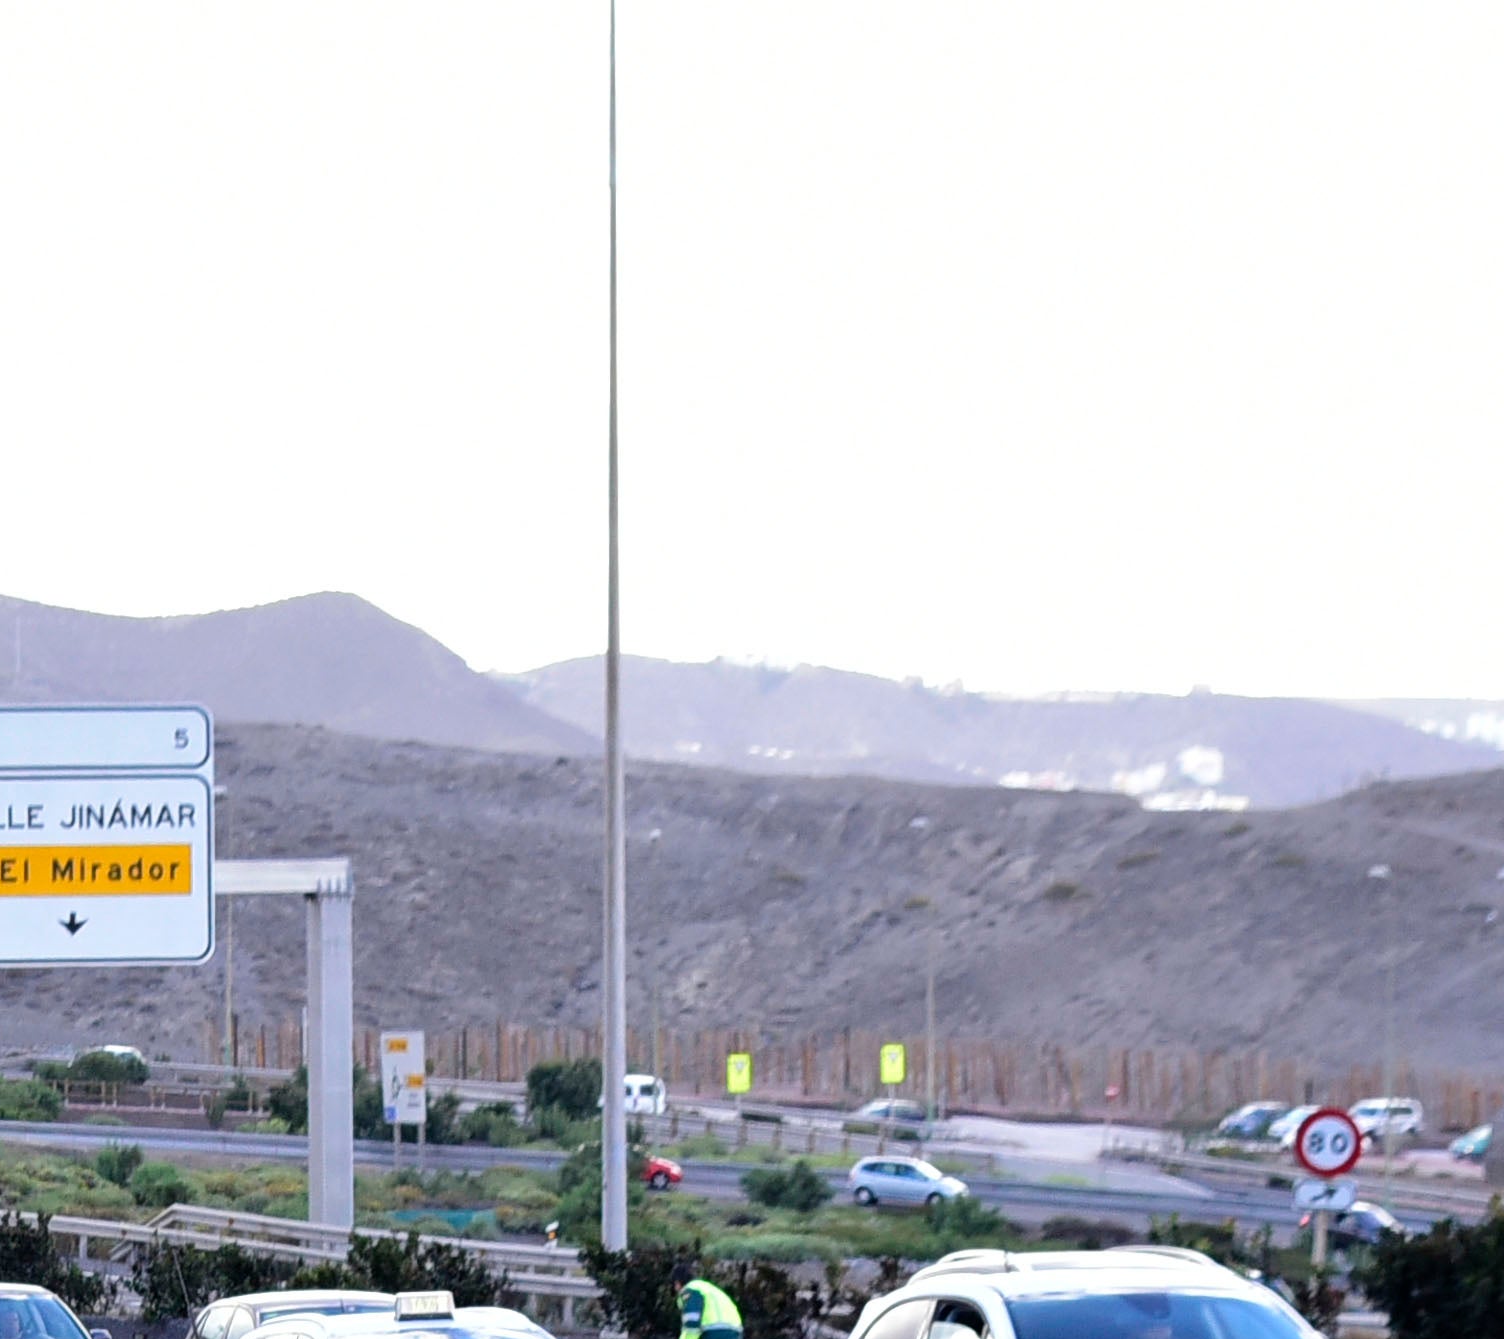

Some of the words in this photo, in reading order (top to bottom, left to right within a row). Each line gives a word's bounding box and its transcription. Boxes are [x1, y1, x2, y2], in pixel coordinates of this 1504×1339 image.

[174, 728, 189, 749] 5
[59, 798, 196, 830] JINÁMAR
[0, 858, 30, 883] El
[51, 857, 180, 883] Mirador
[1308, 1130, 1349, 1155] 80
